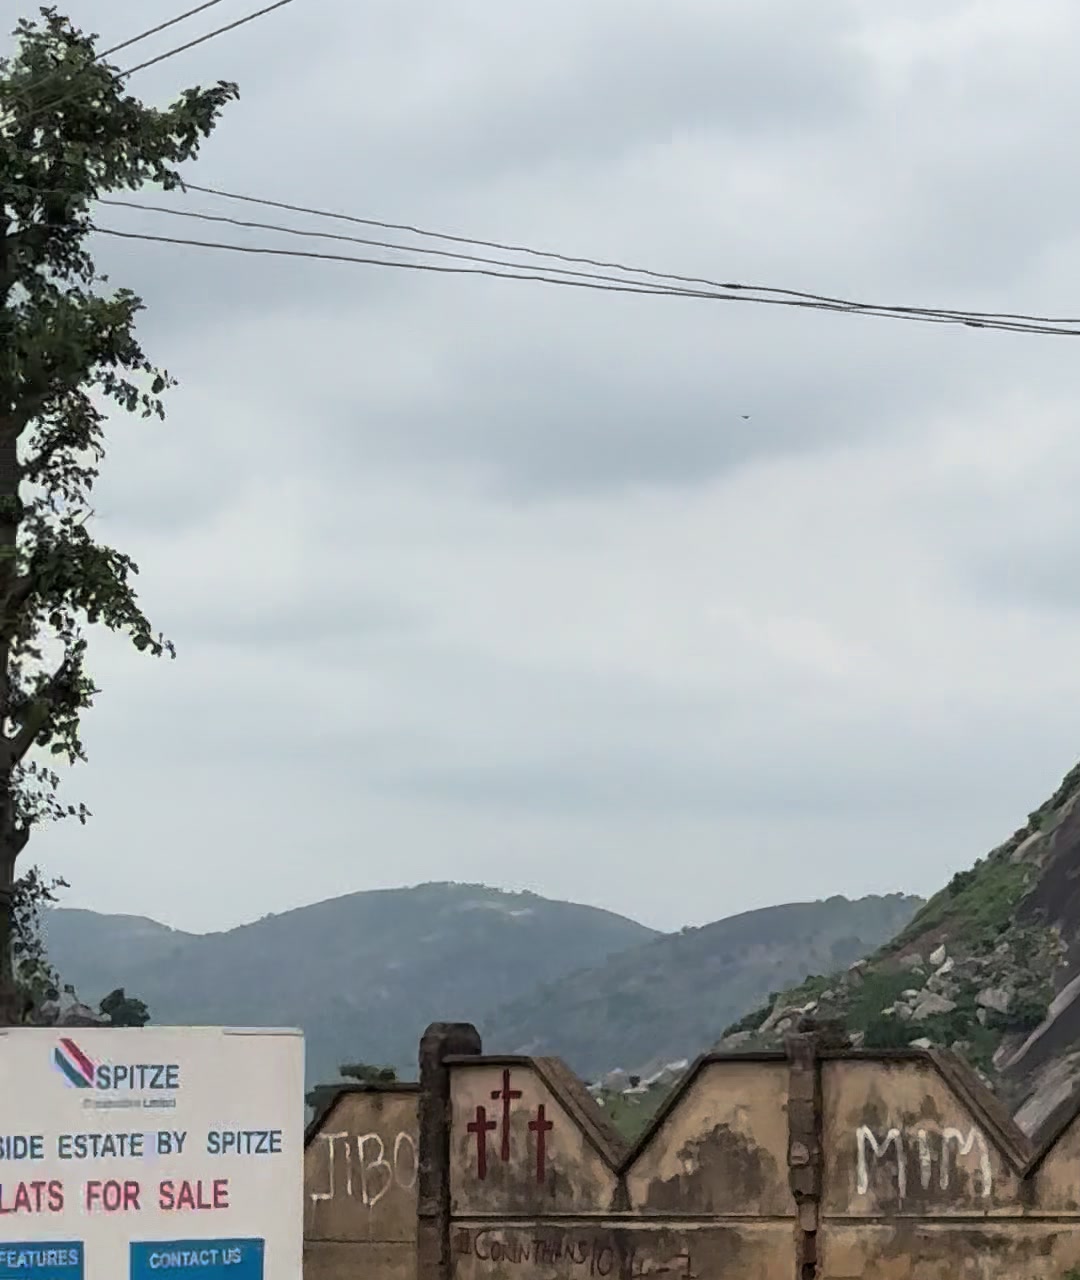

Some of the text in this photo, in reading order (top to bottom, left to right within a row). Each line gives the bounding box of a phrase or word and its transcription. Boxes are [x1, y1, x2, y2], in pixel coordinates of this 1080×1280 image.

[97, 1064, 180, 1090] SPITZE
[58, 1132, 144, 1160] ESTATE
[157, 1130, 188, 1155] BY
[207, 1129, 282, 1155] SPITZE
[86, 1179, 141, 1211] FOR
[159, 1178, 229, 1211] SALE
[149, 1247, 242, 1269] CONTACT US
